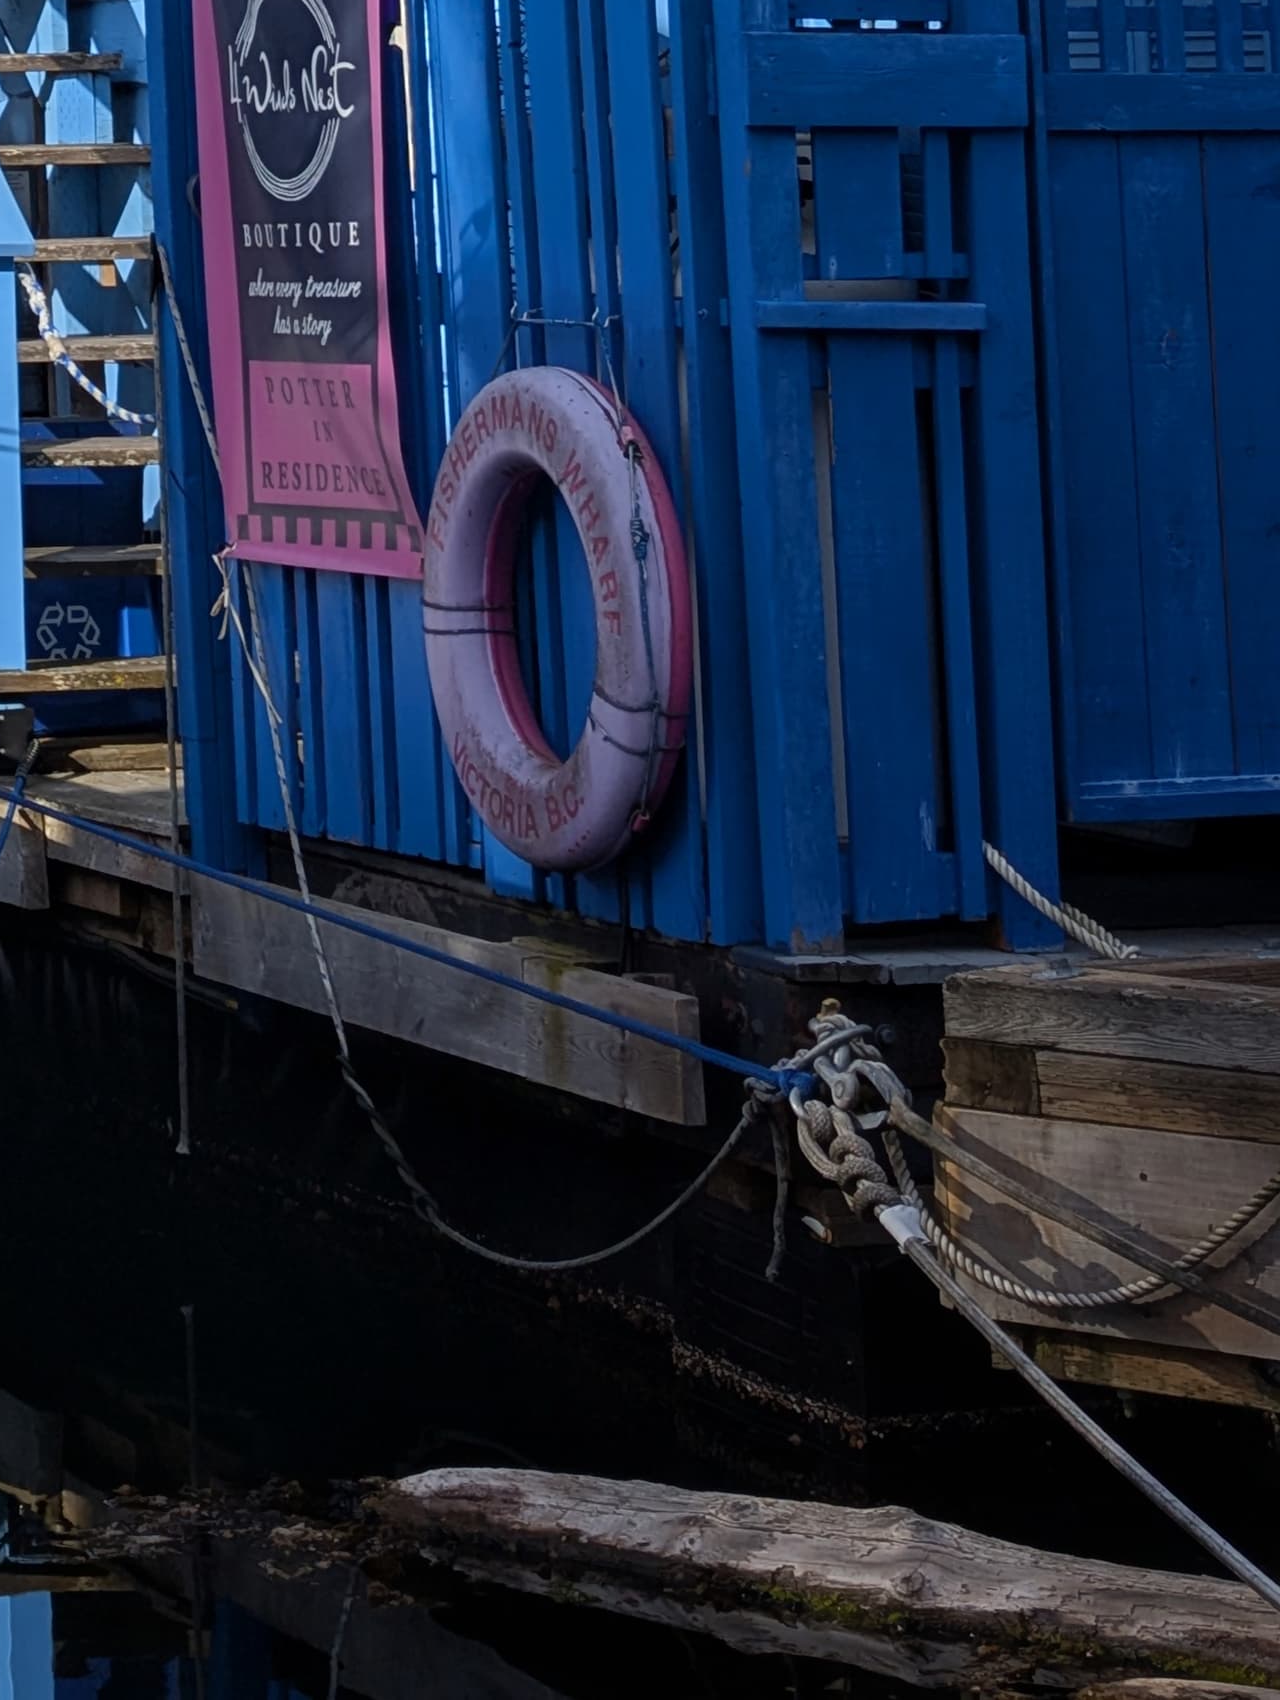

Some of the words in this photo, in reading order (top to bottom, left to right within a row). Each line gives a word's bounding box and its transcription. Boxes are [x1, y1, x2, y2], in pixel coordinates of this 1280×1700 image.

[301, 42, 356, 118] Nest
[242, 221, 360, 254] BOUTIQUE
[275, 281, 303, 308] every
[304, 275, 362, 298] treasure
[273, 304, 291, 335] has
[293, 318, 300, 335] a
[301, 313, 332, 346] story
[264, 376, 355, 409] POTTER
[313, 419, 334, 442] IN
[261, 461, 386, 497] RESIDENCE
[430, 392, 558, 552] FISHERMANS
[561, 449, 622, 636] WHARF
[453, 731, 540, 839] VICTORIA
